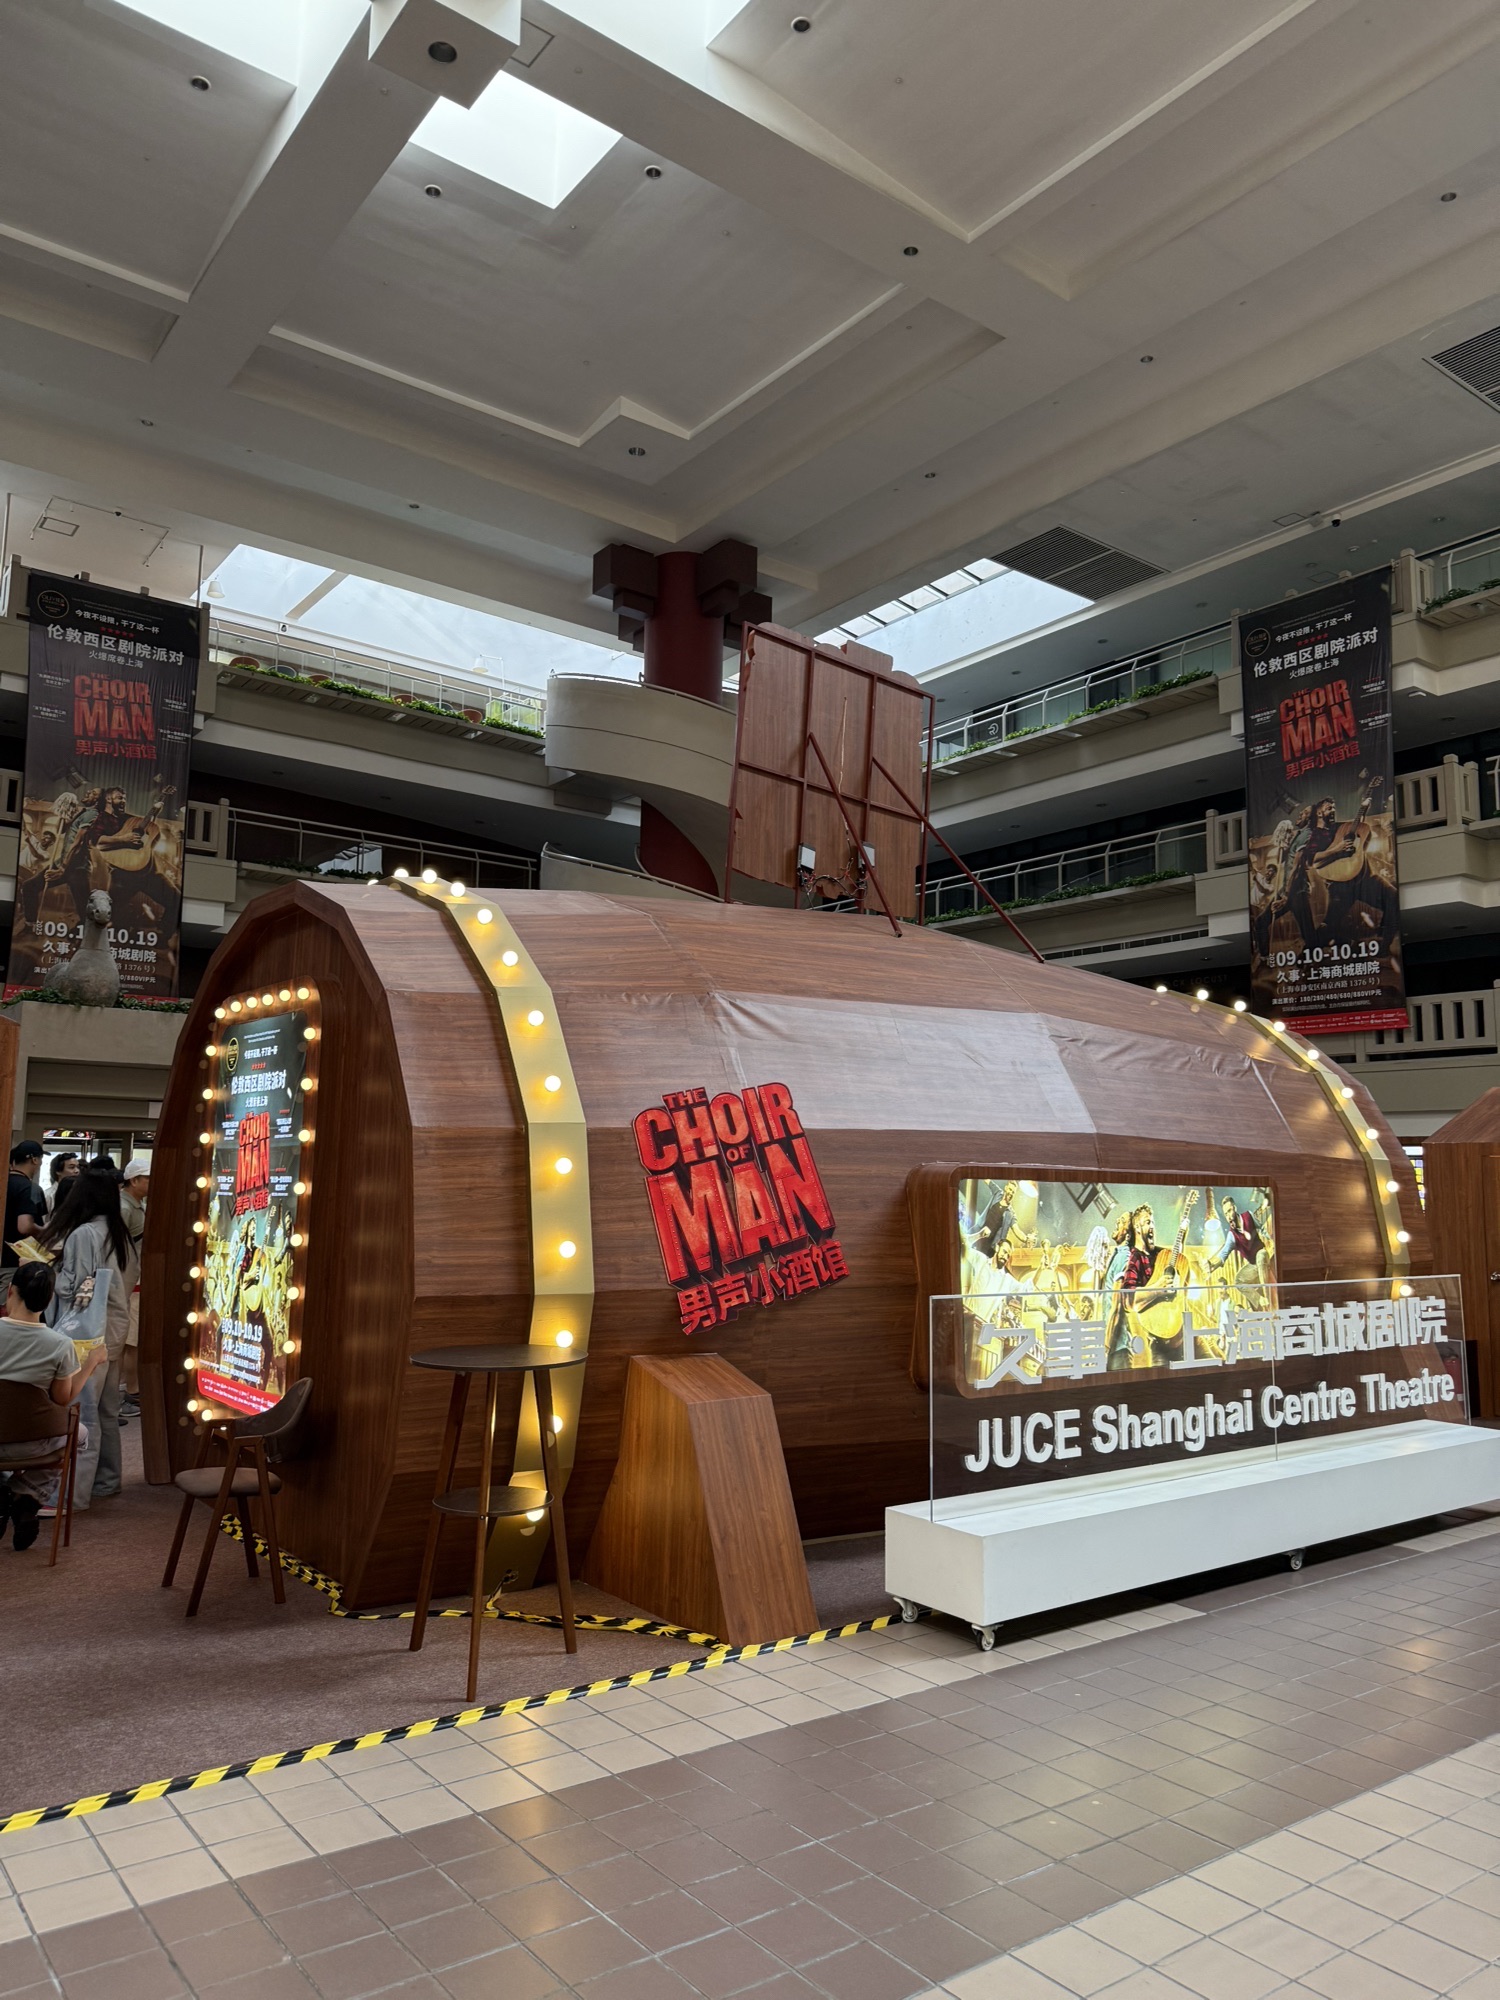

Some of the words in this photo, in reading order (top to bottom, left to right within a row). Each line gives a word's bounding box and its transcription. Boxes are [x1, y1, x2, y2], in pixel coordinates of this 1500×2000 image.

[46, 623, 184, 666] 伦敦西区剧院派对
[89, 650, 144, 669] 火爆席卷上海
[1253, 627, 1379, 678] 伦敦西区剧院派对
[1289, 657, 1340, 680] 火爆席卷上海
[74, 674, 152, 705] CHOIR
[1279, 679, 1351, 723] CHOIR
[73, 698, 156, 741] MAN
[1280, 701, 1358, 763] MAN
[75, 739, 157, 760] 男声小酒馆
[1285, 741, 1361, 780] 男声小酒馆
[1276, 940, 1380, 967] 09.10-10.19
[1276, 961, 1380, 984] 久事·上海商城剧院
[231, 1069, 287, 1095] 伦敦西区剧院派对
[663, 1087, 707, 1109] THE
[239, 1111, 270, 1147] CHOIR
[633, 1082, 805, 1171] CHOIR
[236, 1138, 270, 1195] MAN
[726, 1145, 751, 1163] OF
[645, 1137, 836, 1285] MAN
[677, 1239, 850, 1336] 男声小酒馆
[974, 1296, 1449, 1389] 久事·上海商城剧院
[964, 1408, 1082, 1473] JUCE
[1091, 1388, 1255, 1453] Shanghai
[1260, 1380, 1356, 1429] Centre
[1360, 1367, 1456, 1414] Theatre
